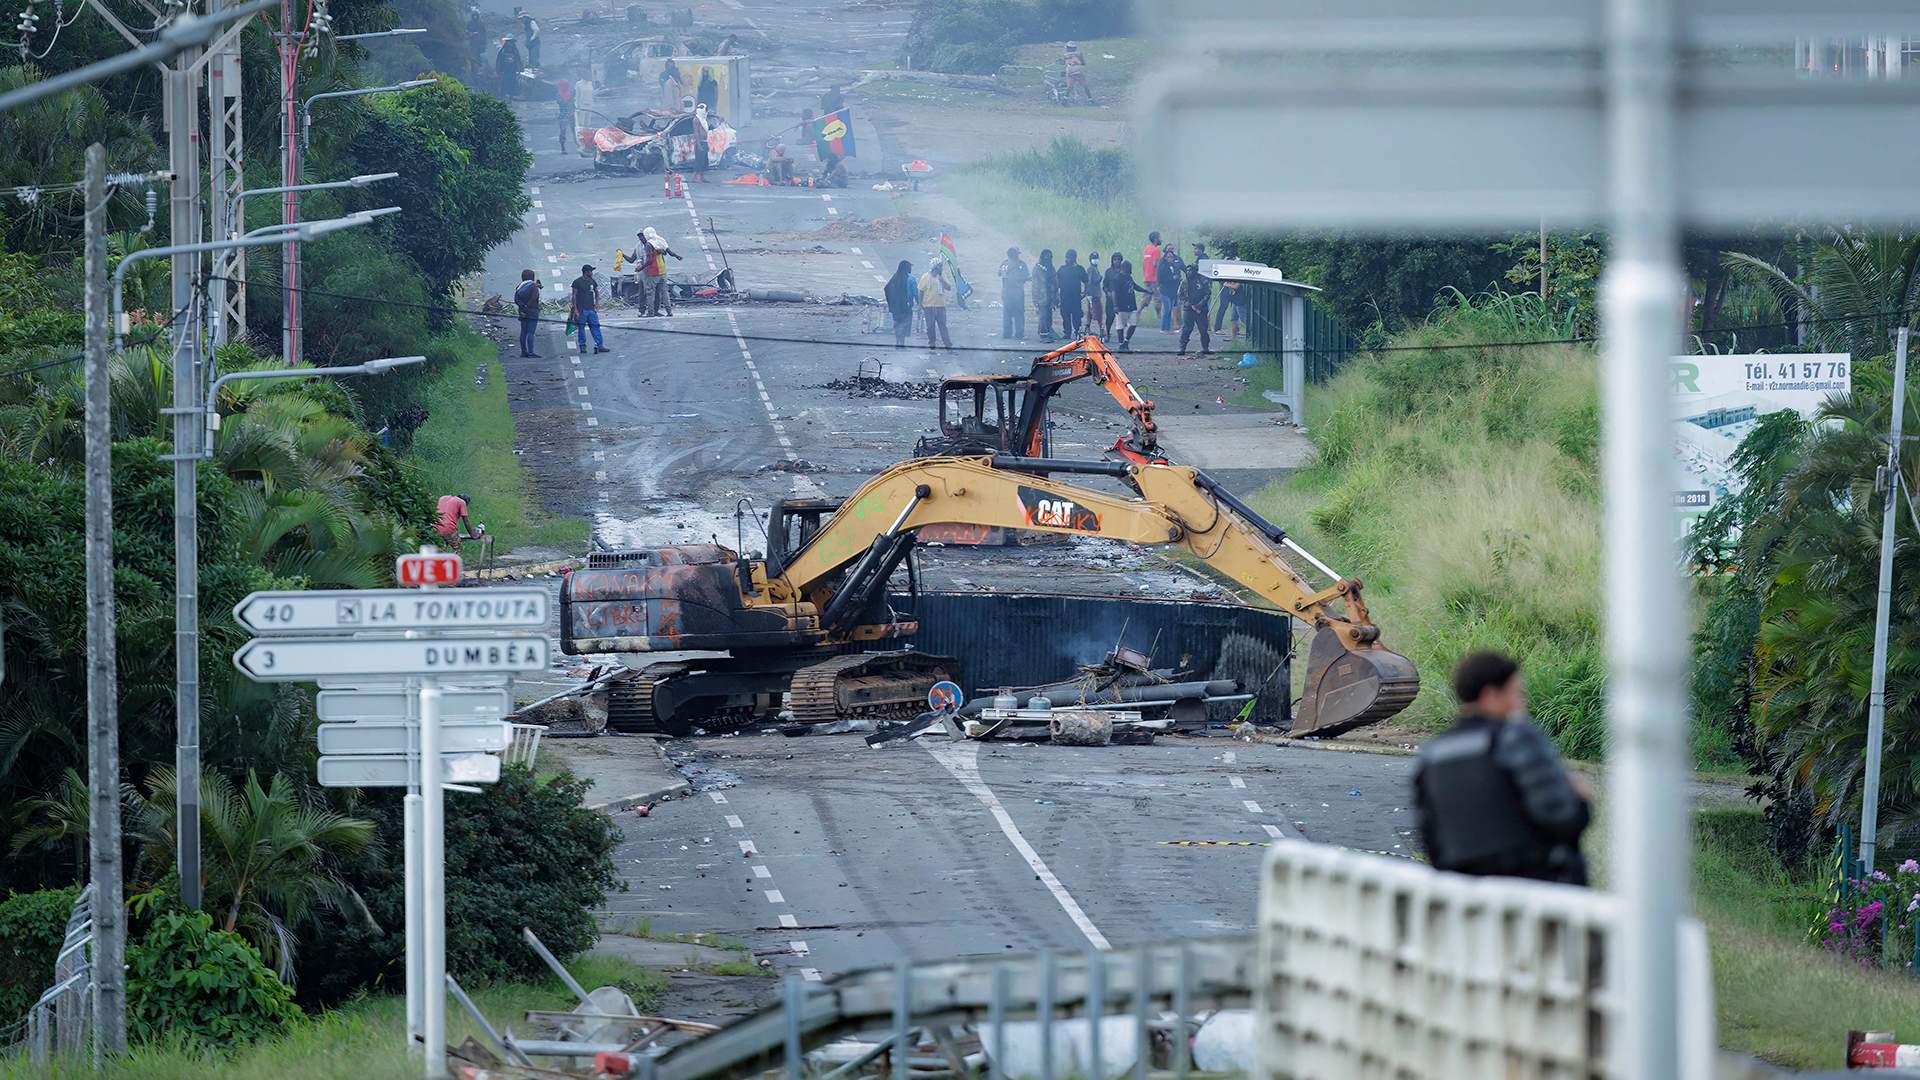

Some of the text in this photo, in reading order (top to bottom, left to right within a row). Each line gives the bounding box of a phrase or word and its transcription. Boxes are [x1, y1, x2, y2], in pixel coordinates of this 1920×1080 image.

[1243, 267, 1262, 276] Meyer
[1745, 361, 1846, 379] Tél. 41 57 76
[1745, 381, 1764, 391] E-mail
[1686, 494, 1706, 504] 2018
[1037, 499, 1074, 527] CAT
[406, 559, 454, 581] VE 1
[263, 600, 538, 623] 40 LA TONTOUTA
[263, 641, 538, 668] 3 DUMBÉA
